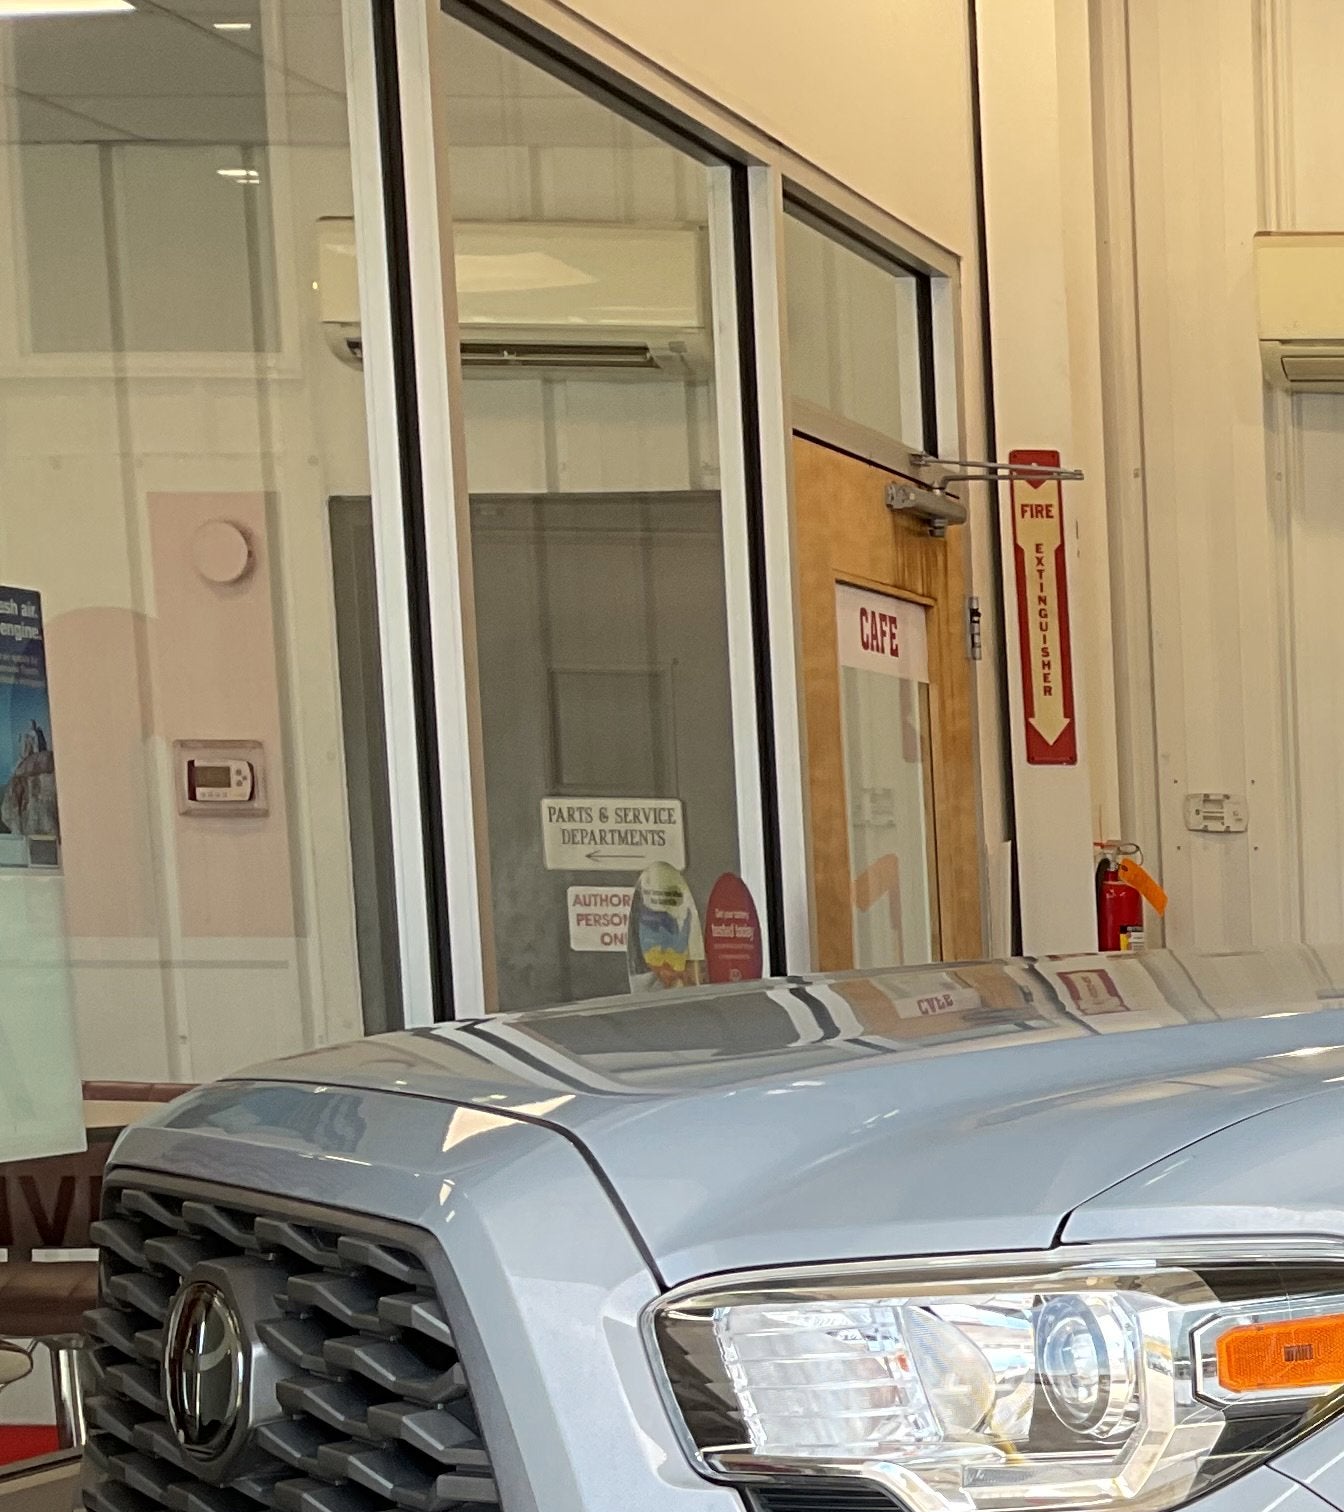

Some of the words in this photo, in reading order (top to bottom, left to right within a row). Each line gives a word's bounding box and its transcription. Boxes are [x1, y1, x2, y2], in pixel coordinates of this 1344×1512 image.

[1020, 503, 1055, 519] FIRE
[1035, 543, 1053, 697] EXTINGUISHER
[860, 607, 900, 658] CAFE
[547, 806, 593, 824] PARTS
[599, 806, 609, 824] &
[614, 807, 677, 825] SERVICE
[561, 828, 666, 846] DEPARTMENTS
